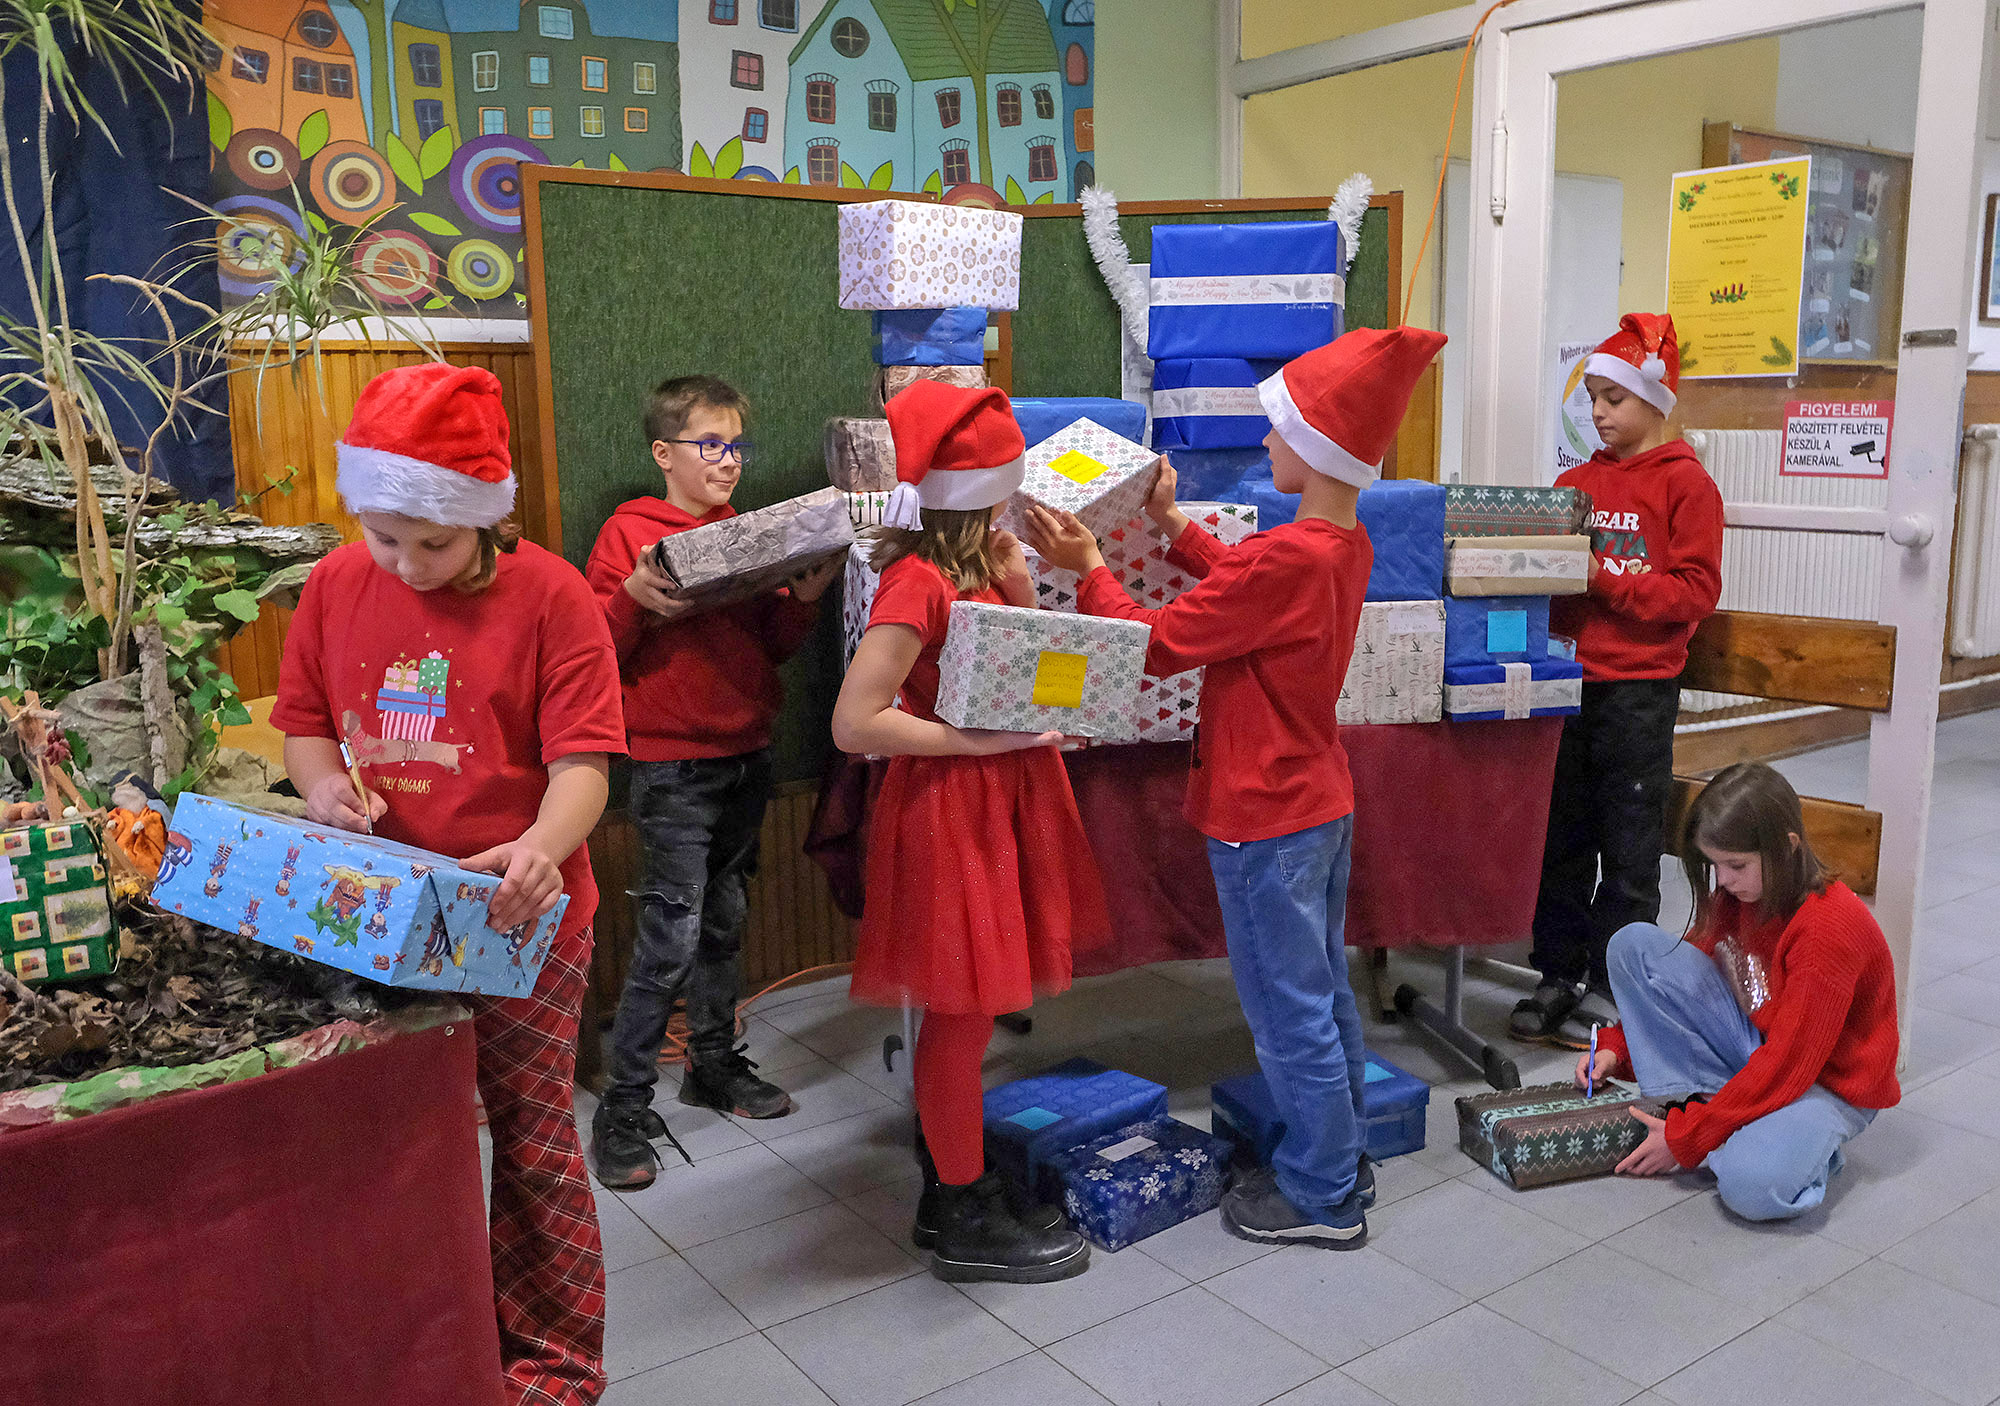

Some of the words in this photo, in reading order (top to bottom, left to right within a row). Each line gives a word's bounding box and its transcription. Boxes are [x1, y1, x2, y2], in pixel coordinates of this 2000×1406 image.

[1800, 403, 1877, 417] FIGYELEM!
[1788, 420, 1838, 435] RÖGZÍTETT
[1840, 421, 1885, 436] FELVÉTEL
[1787, 436, 1821, 451] KÉSZÜL
[1824, 439, 1831, 451] A
[397, 777, 432, 794] DOGMAS
